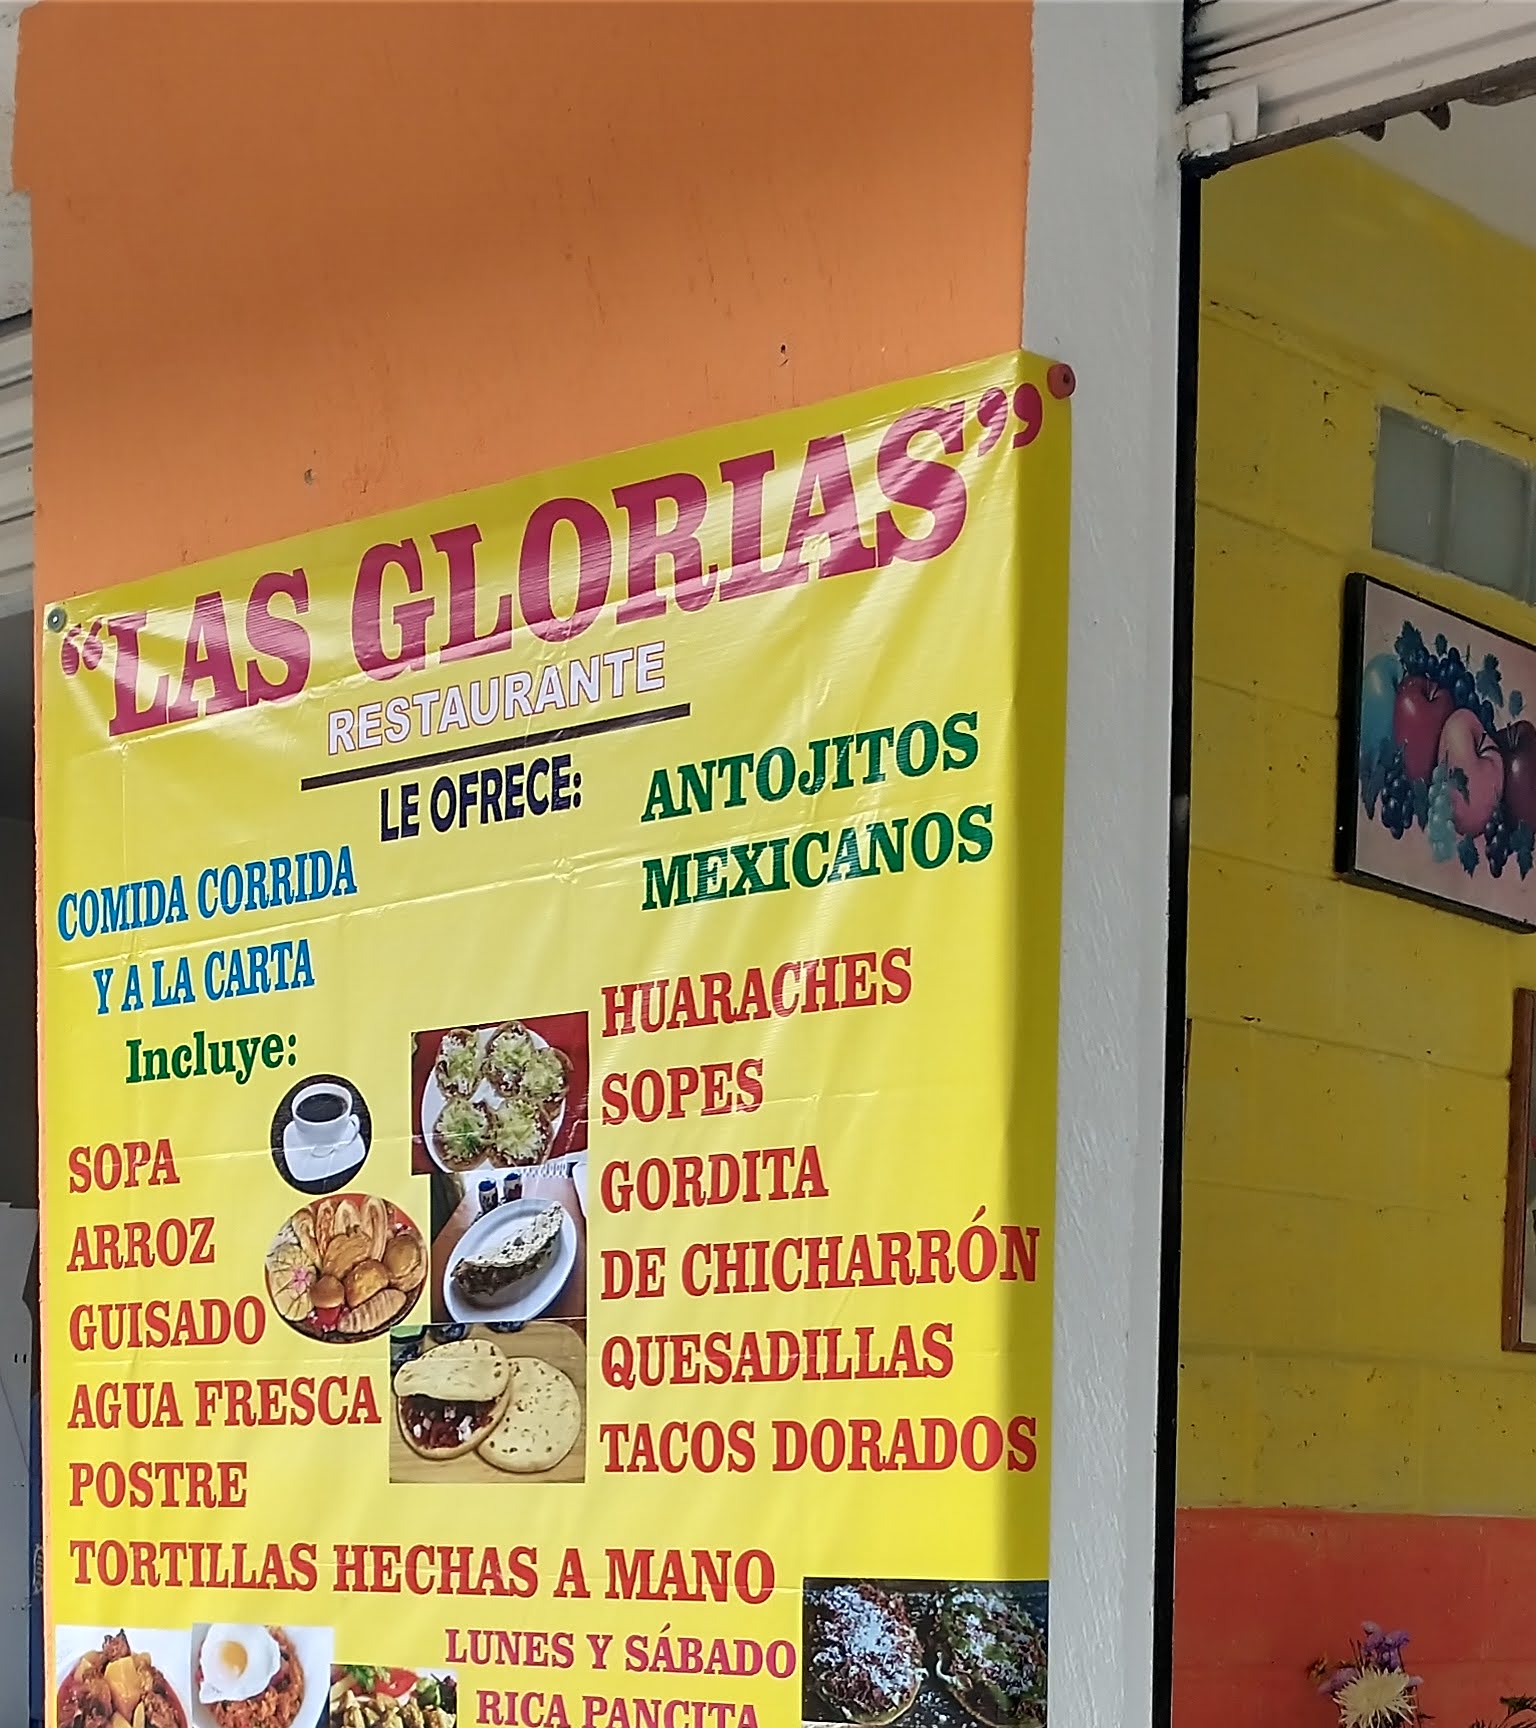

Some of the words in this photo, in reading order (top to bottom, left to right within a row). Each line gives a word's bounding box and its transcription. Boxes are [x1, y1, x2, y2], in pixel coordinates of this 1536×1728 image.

[326, 640, 667, 758] RESTAURANTE
[380, 783, 419, 842] LE
[430, 754, 582, 832] OFRECE:
[641, 712, 978, 823] ANTOJITOS
[641, 804, 992, 910] MEXICANOS
[57, 874, 190, 942] COMIDA
[196, 845, 359, 920] CORRIDA
[92, 967, 115, 1015] Y
[120, 964, 145, 1012] A
[151, 956, 197, 1008] LA
[203, 938, 316, 1001] CARTA
[601, 947, 911, 1037] HUARACHES
[126, 1031, 296, 1085] Incluye:
[602, 1059, 763, 1125] SOPES
[69, 1139, 180, 1193] SOPA
[601, 1146, 829, 1213] GORDITA
[67, 1217, 214, 1272] ARROZ
[601, 1248, 665, 1300] DE
[682, 1206, 1040, 1296] CHICHARRÓN
[70, 1296, 266, 1351] GUISADO
[601, 1323, 953, 1390] QUESADILLAS
[68, 1382, 183, 1429] AGUA
[195, 1376, 381, 1427] FRESCA
[600, 1420, 755, 1473] TACOS
[772, 1415, 1037, 1472] DORADOS
[70, 1462, 247, 1508] POSTRE
[70, 1540, 317, 1591] TORTILLAS
[334, 1545, 538, 1598] HECHAS
[553, 1548, 591, 1598] A
[605, 1549, 774, 1604] MANO
[445, 1629, 574, 1669] LUNES
[586, 1634, 613, 1670] Y
[625, 1623, 797, 1679] SÁBADO
[476, 1690, 571, 1728] RICA
